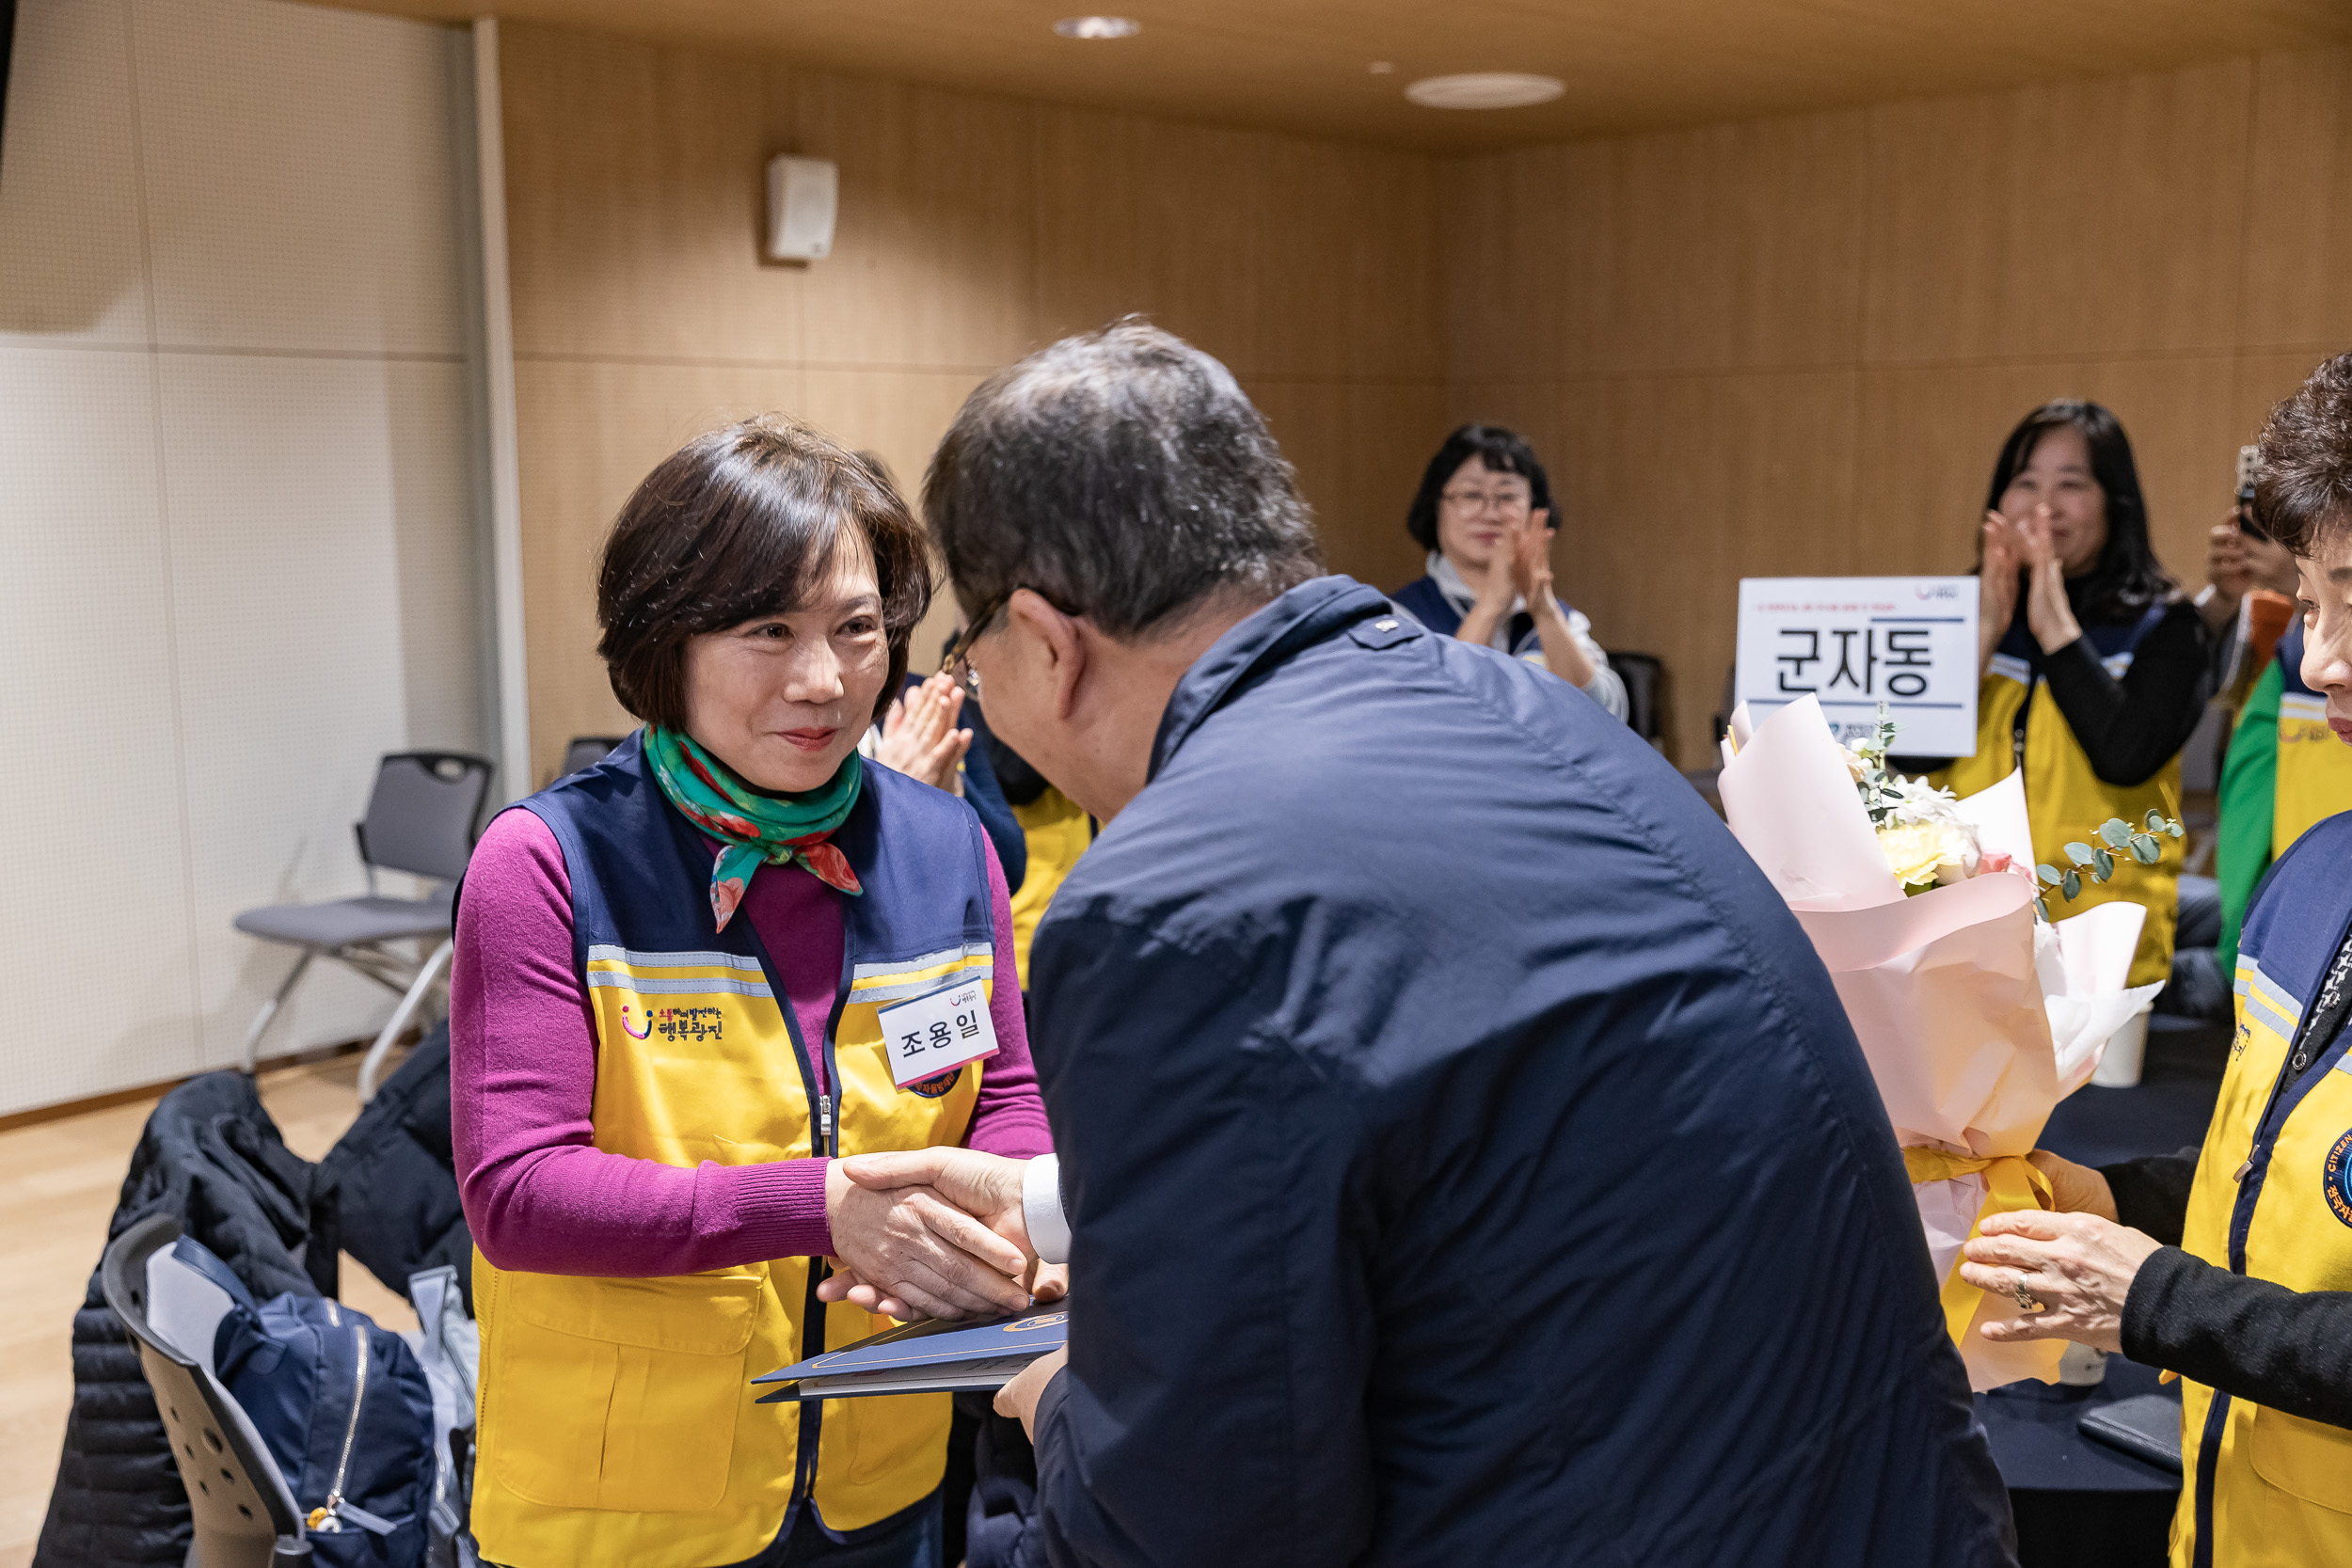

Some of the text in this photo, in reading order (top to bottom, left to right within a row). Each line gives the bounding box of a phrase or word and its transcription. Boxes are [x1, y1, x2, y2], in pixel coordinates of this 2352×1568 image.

[1777, 629, 1931, 696] 군자동
[658, 1020, 723, 1042] 행복광진
[901, 1009, 980, 1058] 조용일
